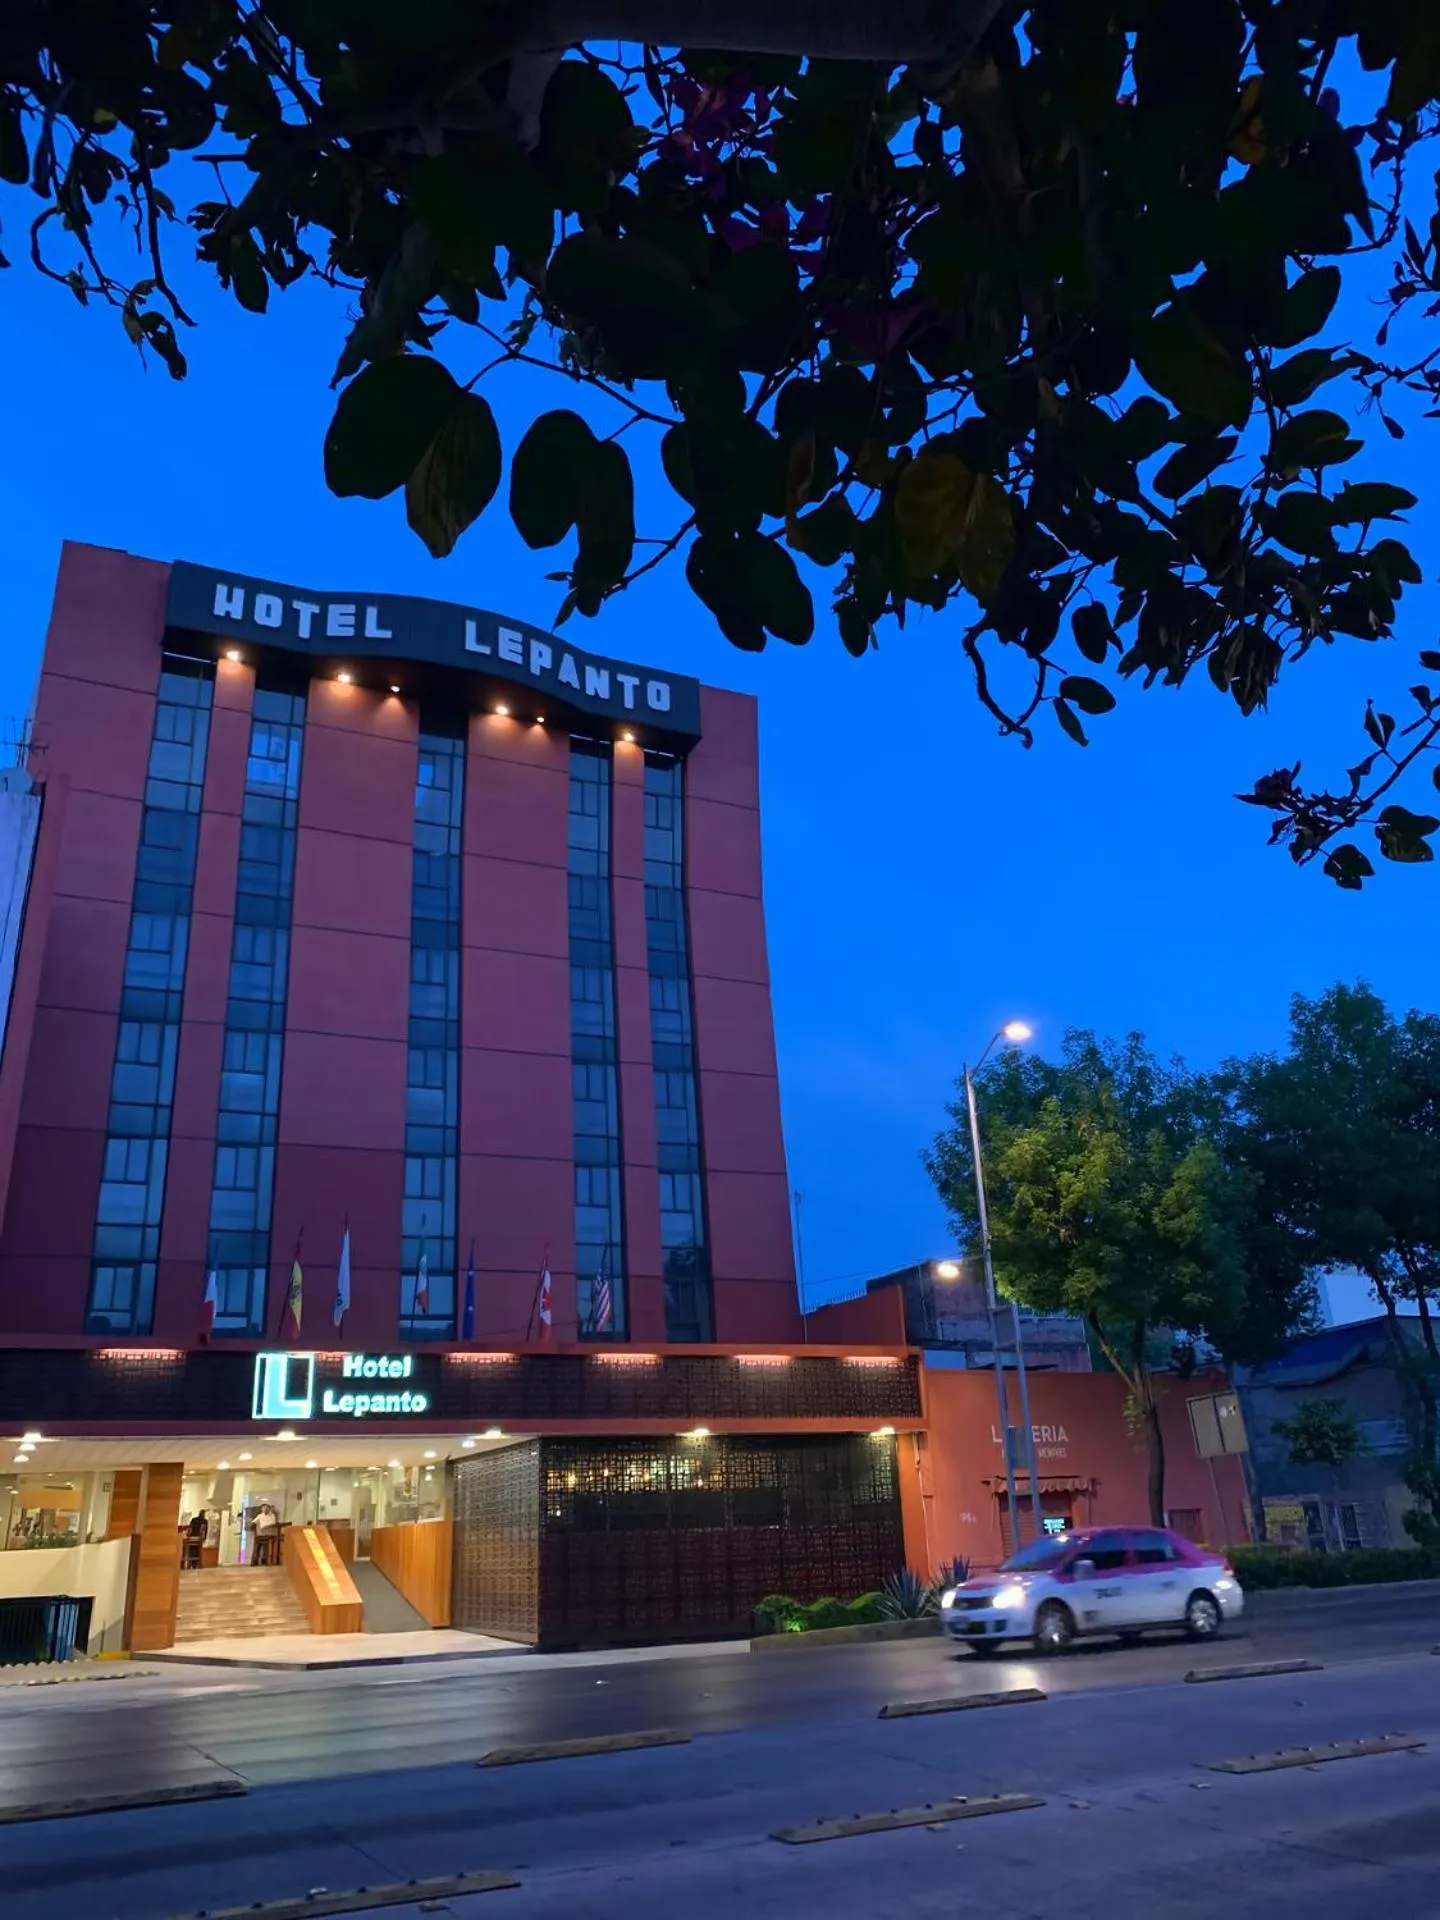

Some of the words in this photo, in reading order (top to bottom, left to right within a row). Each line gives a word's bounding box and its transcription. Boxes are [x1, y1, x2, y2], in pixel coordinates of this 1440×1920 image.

[213, 585, 392, 638] HOTEL
[465, 620, 670, 712] LEPANTO
[343, 1355, 412, 1377] Hotel
[323, 1391, 427, 1416] Lepanto
[992, 1425, 1068, 1443] LERIA
